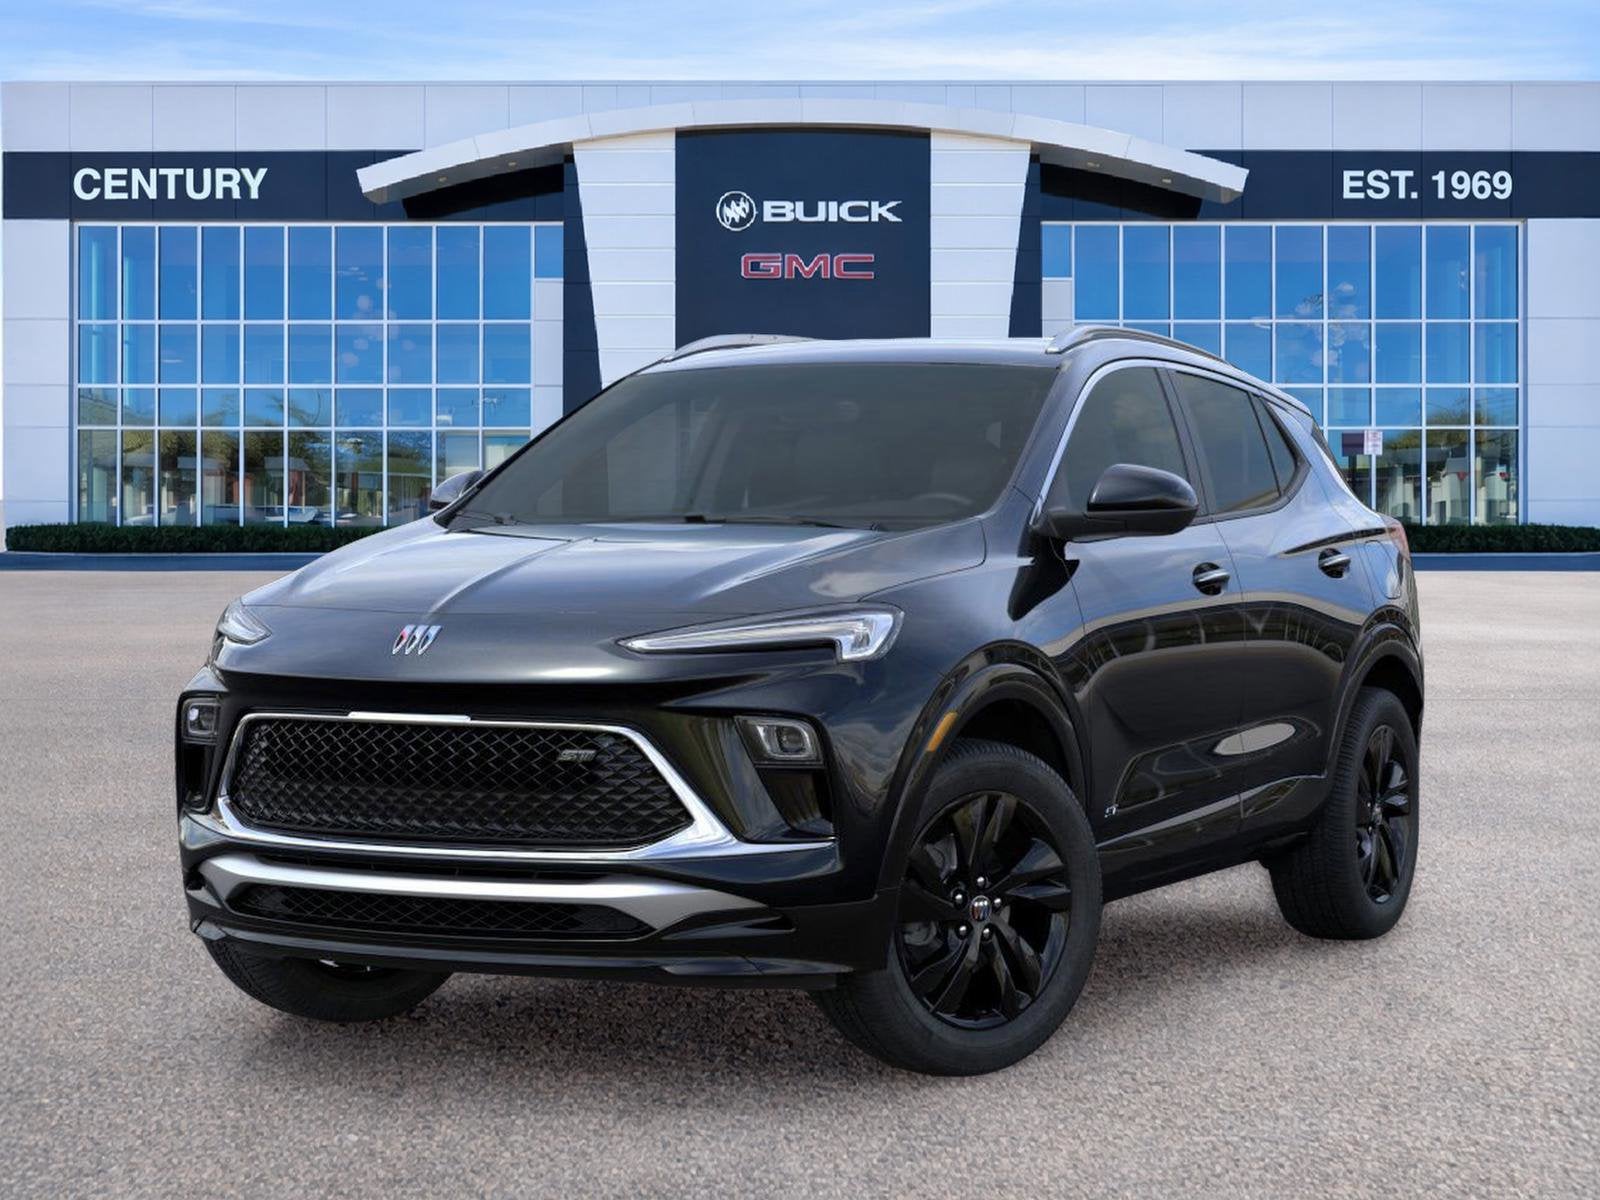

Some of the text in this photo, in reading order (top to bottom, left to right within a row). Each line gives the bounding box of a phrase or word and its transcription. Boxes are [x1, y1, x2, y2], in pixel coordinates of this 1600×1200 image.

[73, 167, 268, 201] CENTURY
[1342, 169, 1513, 200] EST. 1969
[762, 200, 903, 223] BUICK
[740, 252, 875, 280] GMC
